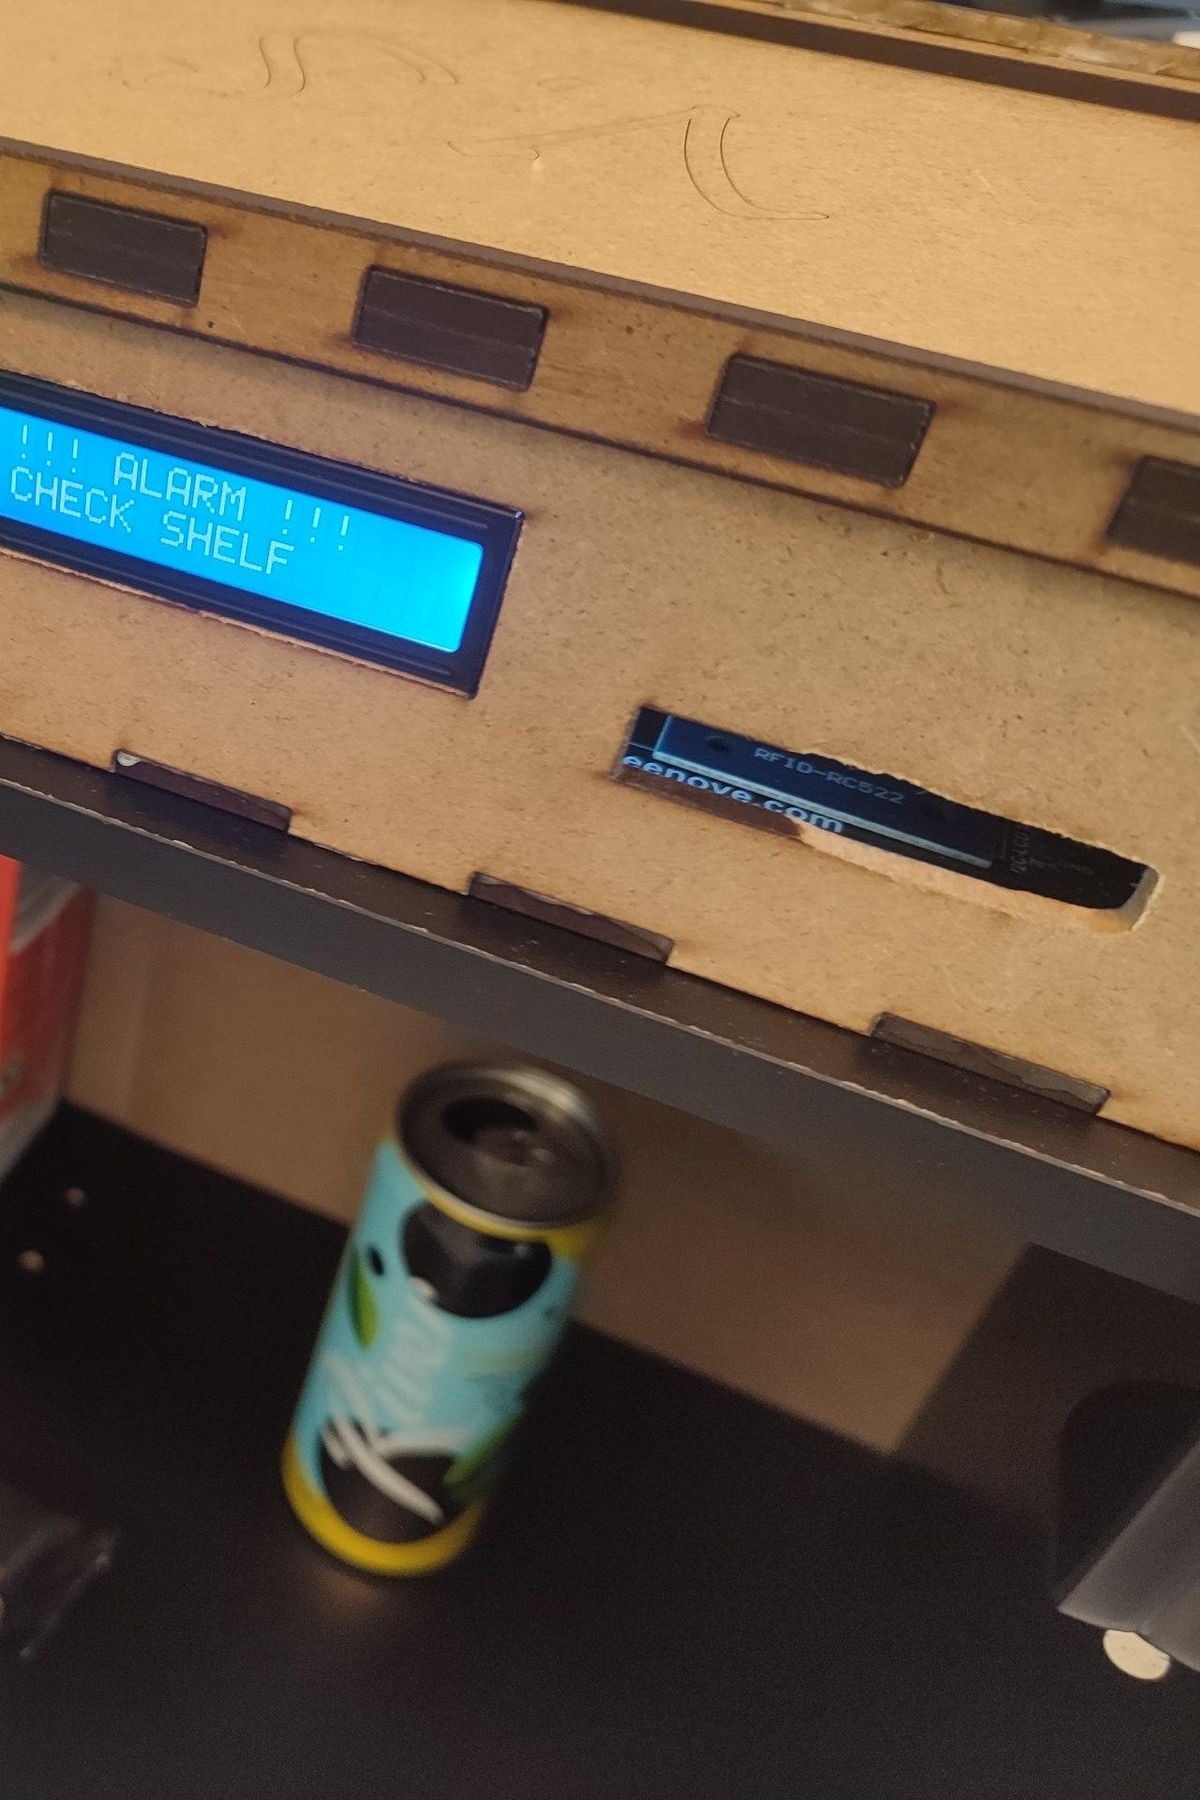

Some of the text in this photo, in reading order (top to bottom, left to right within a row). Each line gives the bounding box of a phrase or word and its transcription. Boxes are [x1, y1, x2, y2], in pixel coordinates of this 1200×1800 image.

[9, 466, 296, 576] CHECK SHELF
[19, 423, 351, 552] !!! ALARM !!!
[622, 754, 844, 834] eenove.com
[753, 747, 906, 805] RFID-RC522
